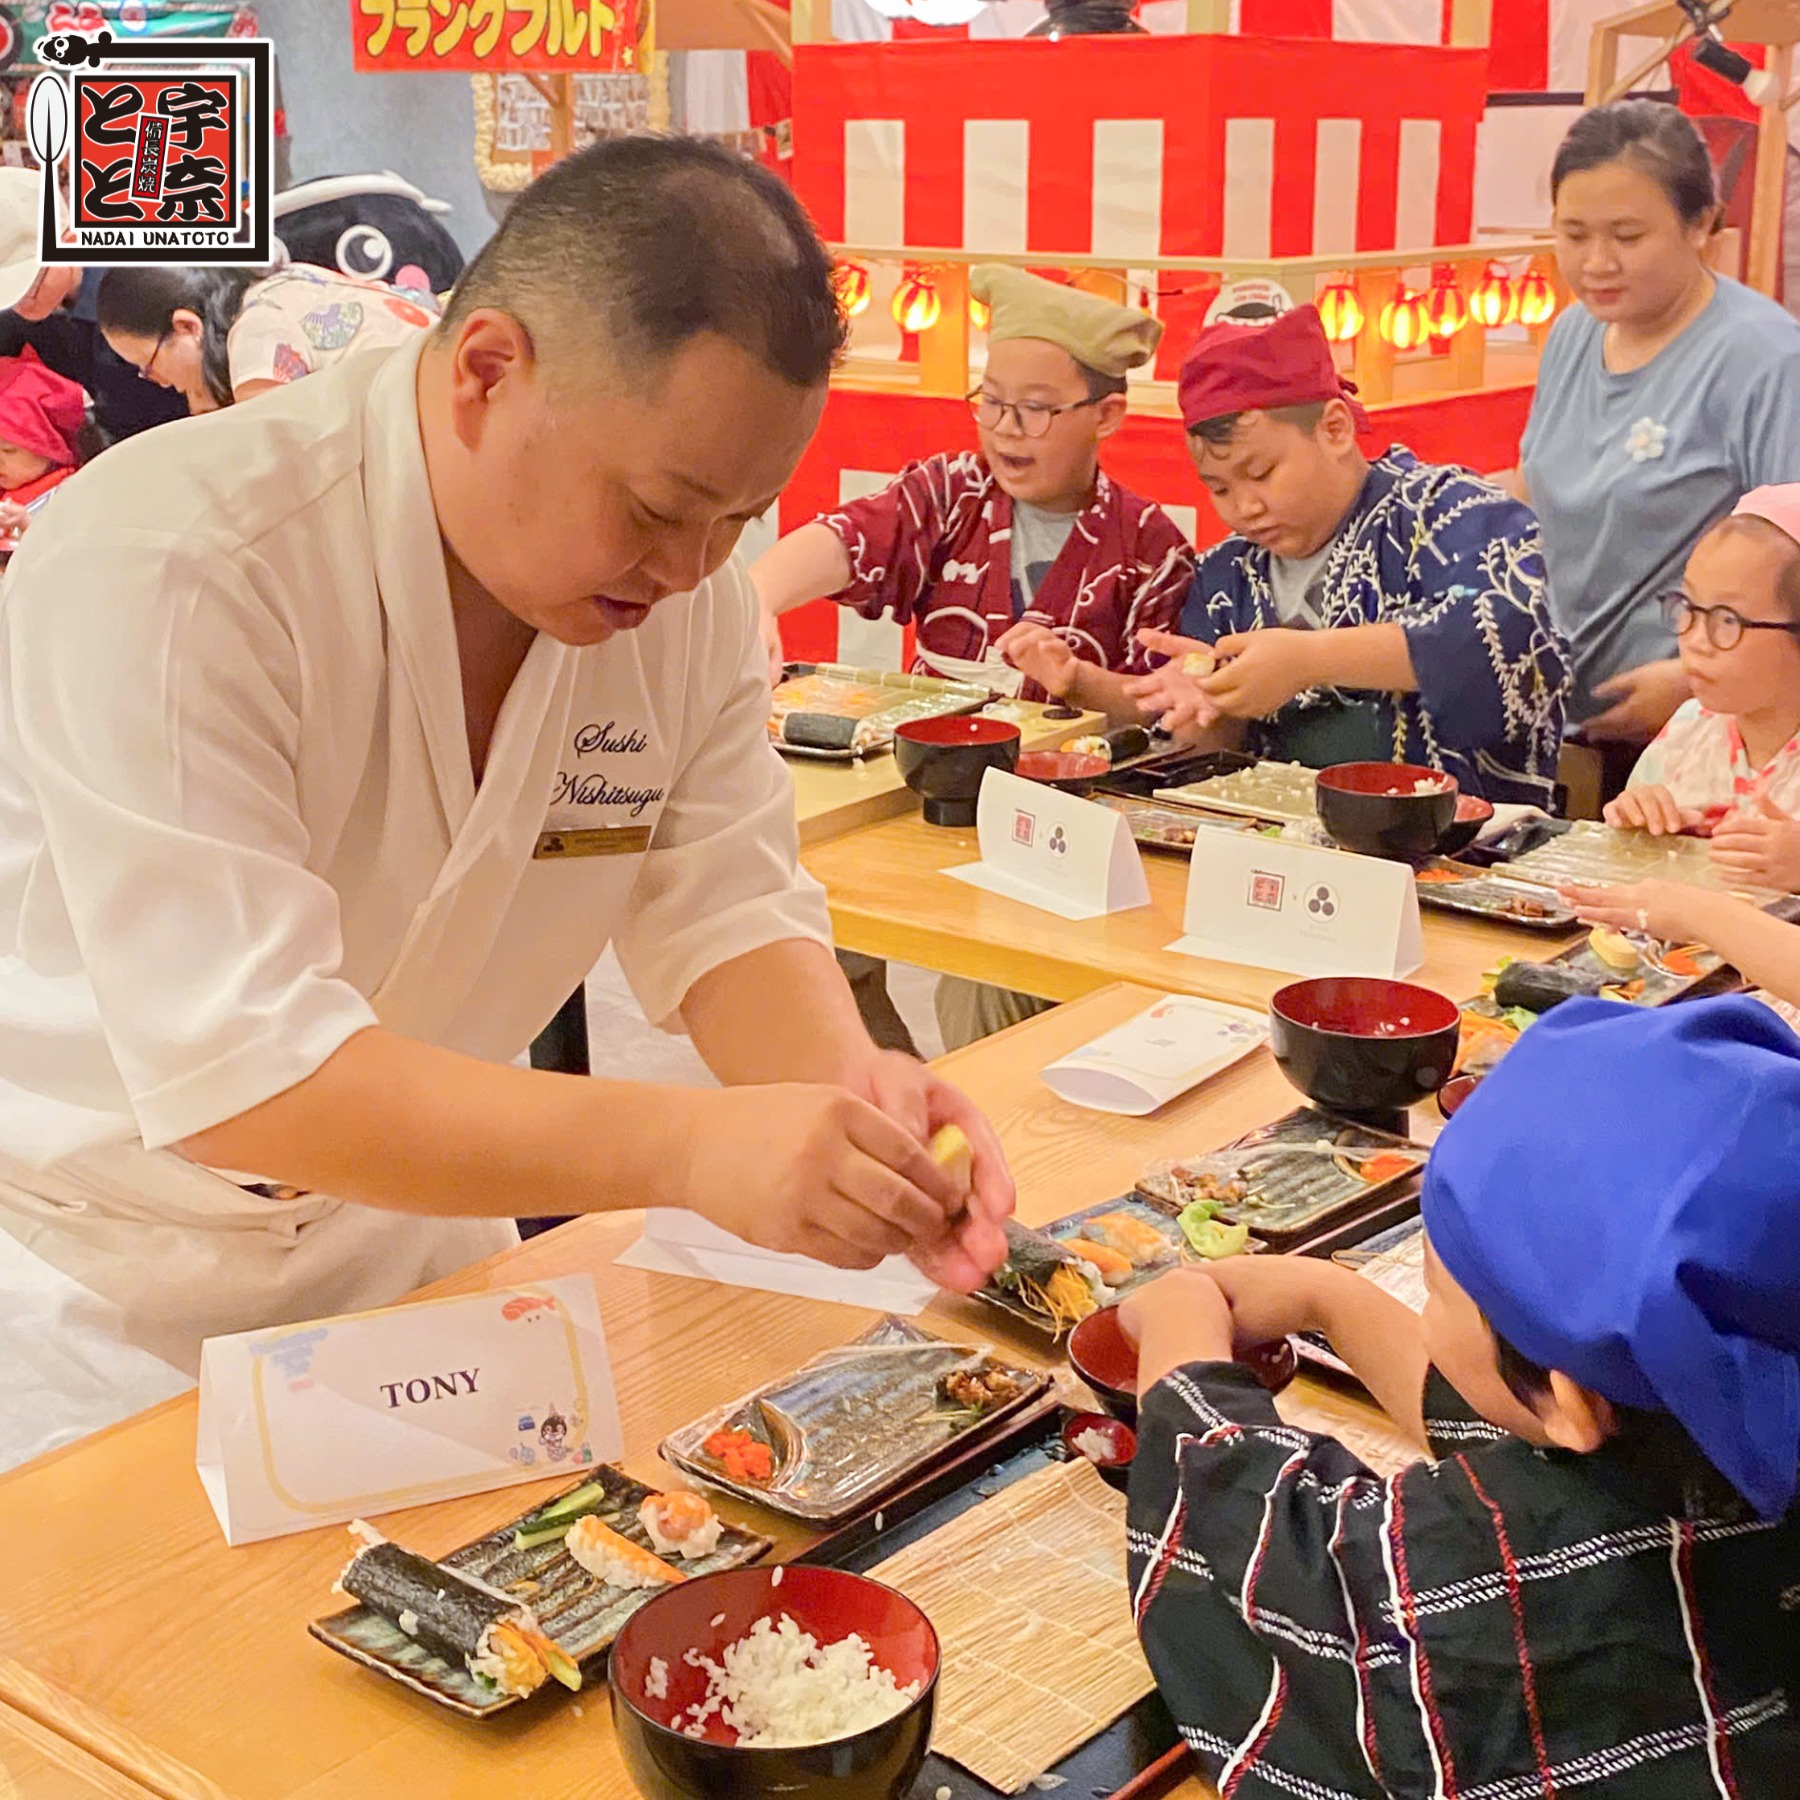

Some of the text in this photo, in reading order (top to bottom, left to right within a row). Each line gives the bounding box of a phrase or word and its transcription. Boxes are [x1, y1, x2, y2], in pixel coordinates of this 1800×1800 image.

[574, 720, 647, 759] Sushi
[550, 771, 664, 818] Nishitsugu
[380, 1367, 481, 1409] TONY
